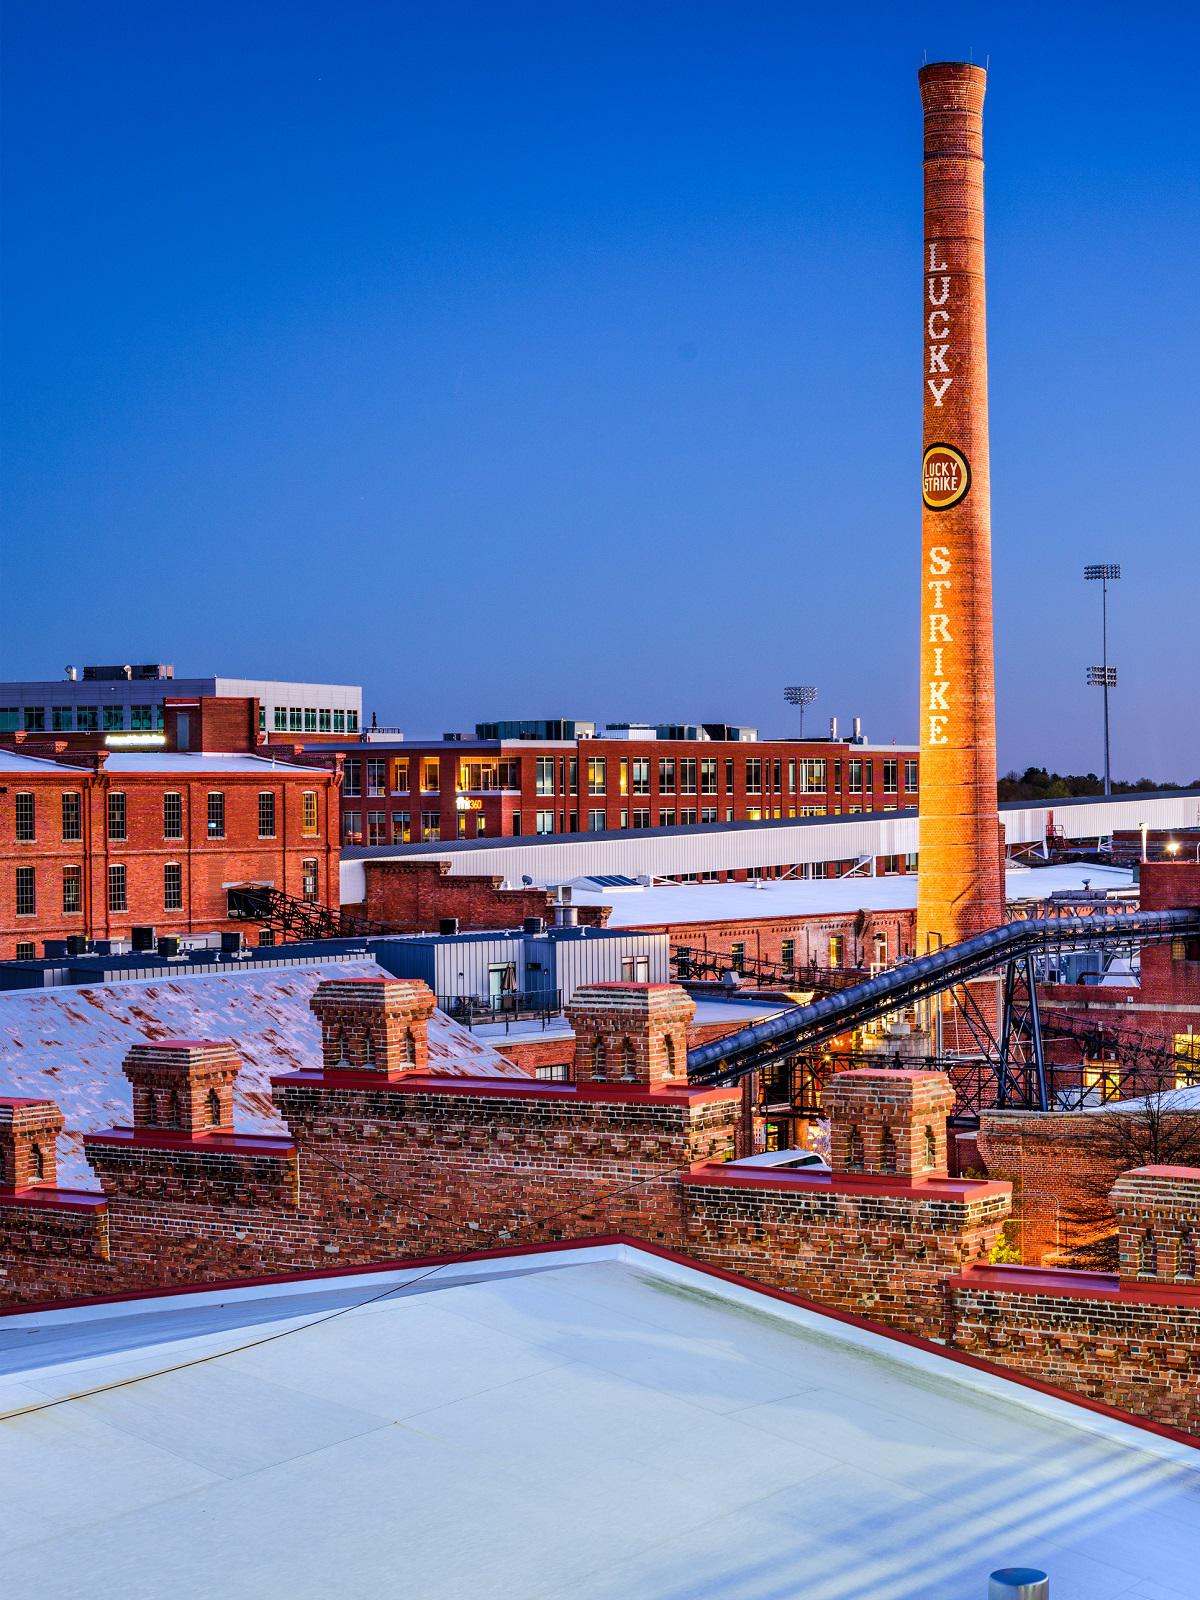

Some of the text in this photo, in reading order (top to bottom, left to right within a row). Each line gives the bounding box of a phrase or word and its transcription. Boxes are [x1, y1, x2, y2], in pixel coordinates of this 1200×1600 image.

[928, 244, 952, 407] LUCKY
[924, 476, 958, 492] STRIKE
[925, 462, 958, 477] LUCKY
[928, 546, 953, 745] STRIKE
